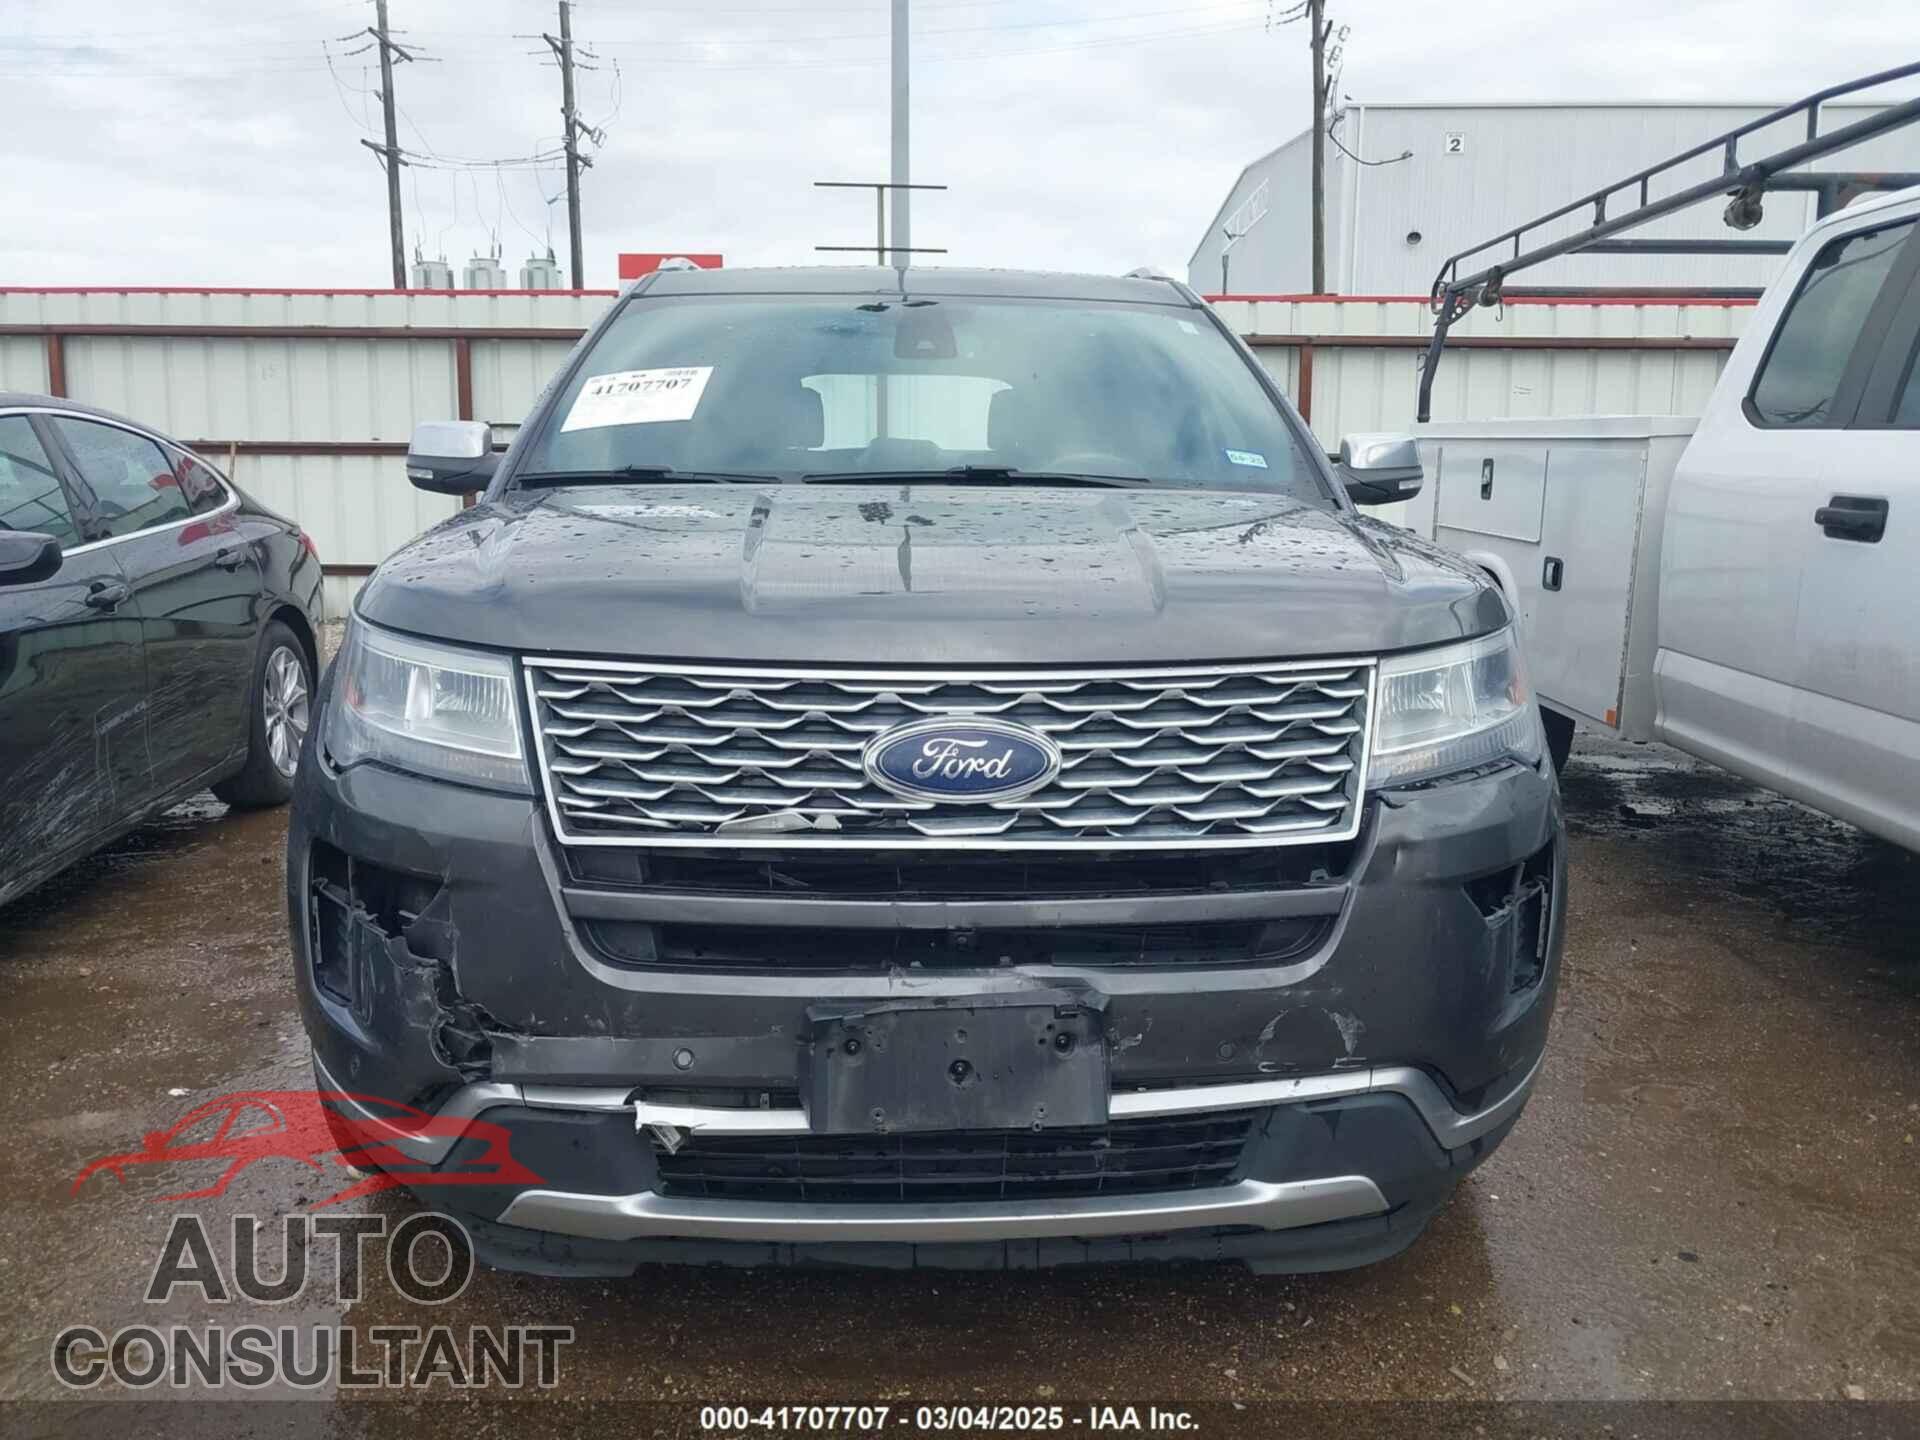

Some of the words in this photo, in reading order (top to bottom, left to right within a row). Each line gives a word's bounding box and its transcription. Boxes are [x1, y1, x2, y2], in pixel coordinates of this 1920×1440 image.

[1449, 138, 1461, 152] 2
[591, 377, 692, 396] 41707707
[912, 738, 1014, 780] Ford
